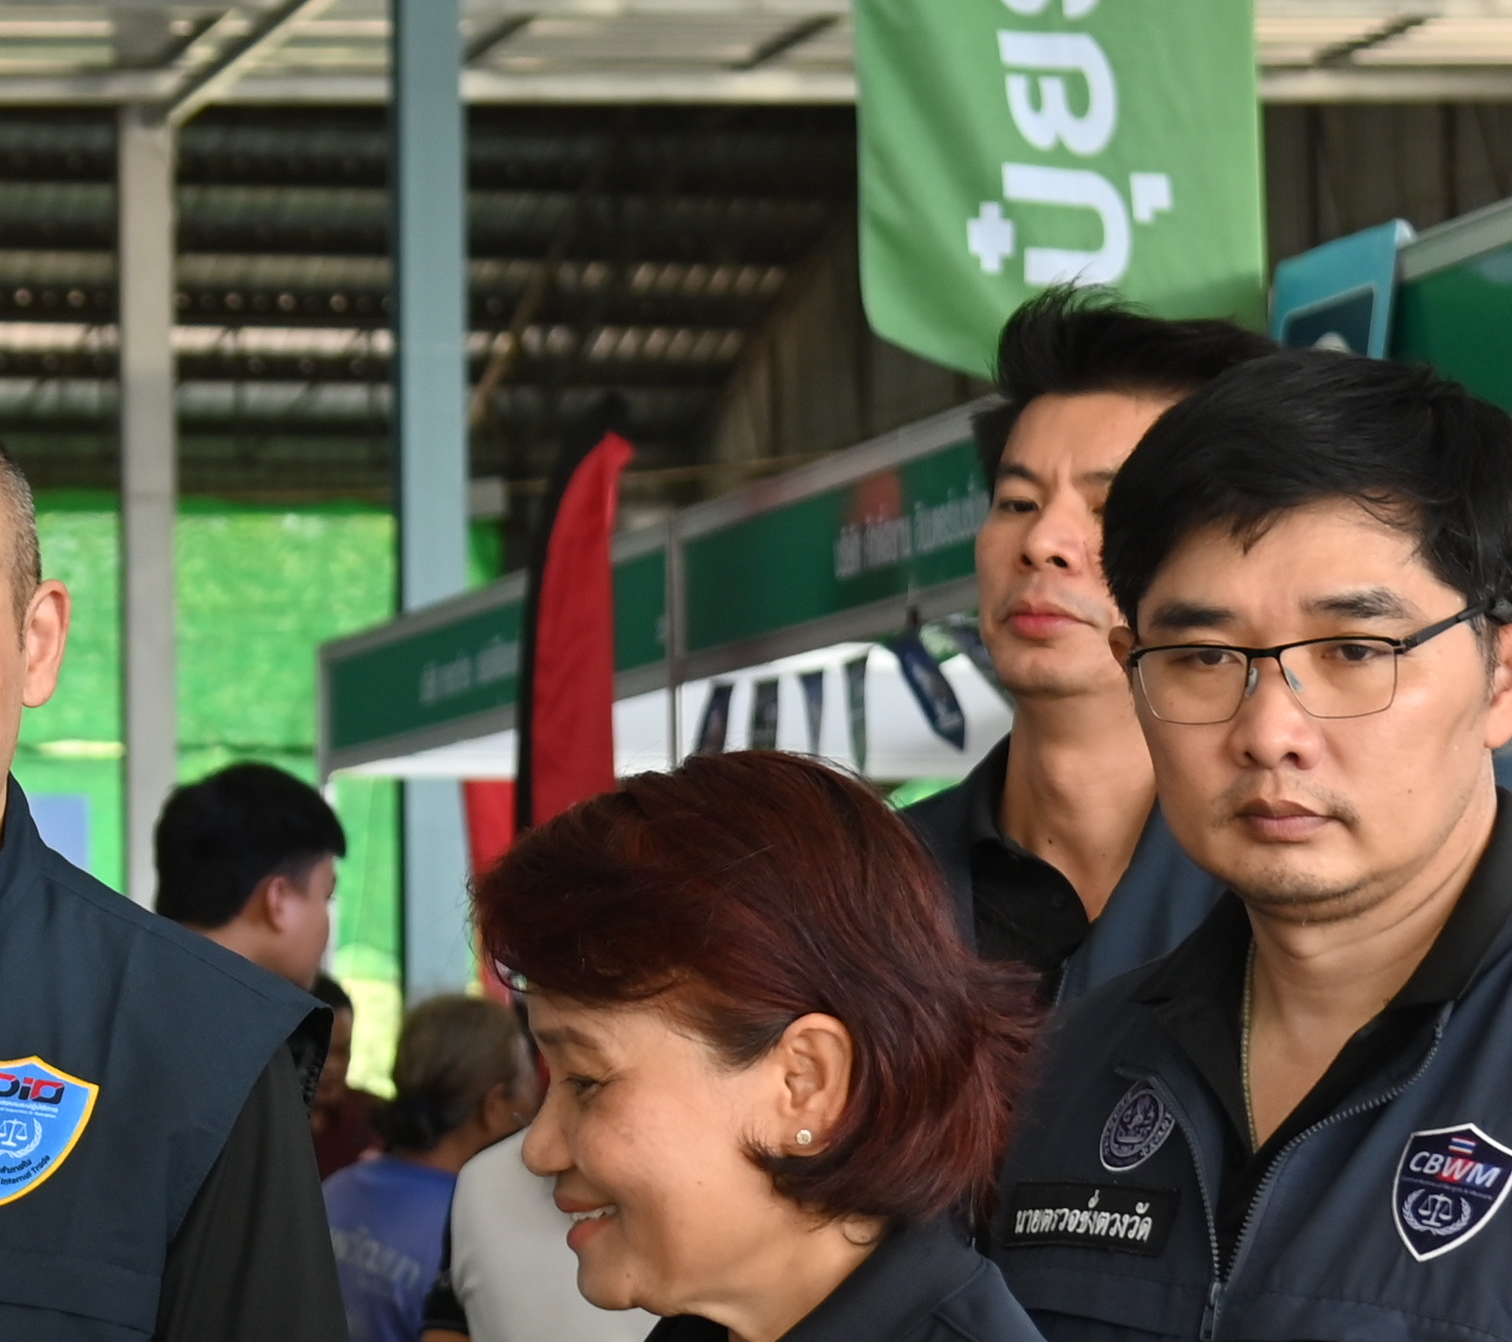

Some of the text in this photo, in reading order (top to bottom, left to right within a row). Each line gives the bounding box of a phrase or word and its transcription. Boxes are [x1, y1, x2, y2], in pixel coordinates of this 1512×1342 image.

[1408, 1149, 1503, 1189] CBWM
[1013, 1188, 1154, 1243] นายตรวจชั่งตวงวัด
